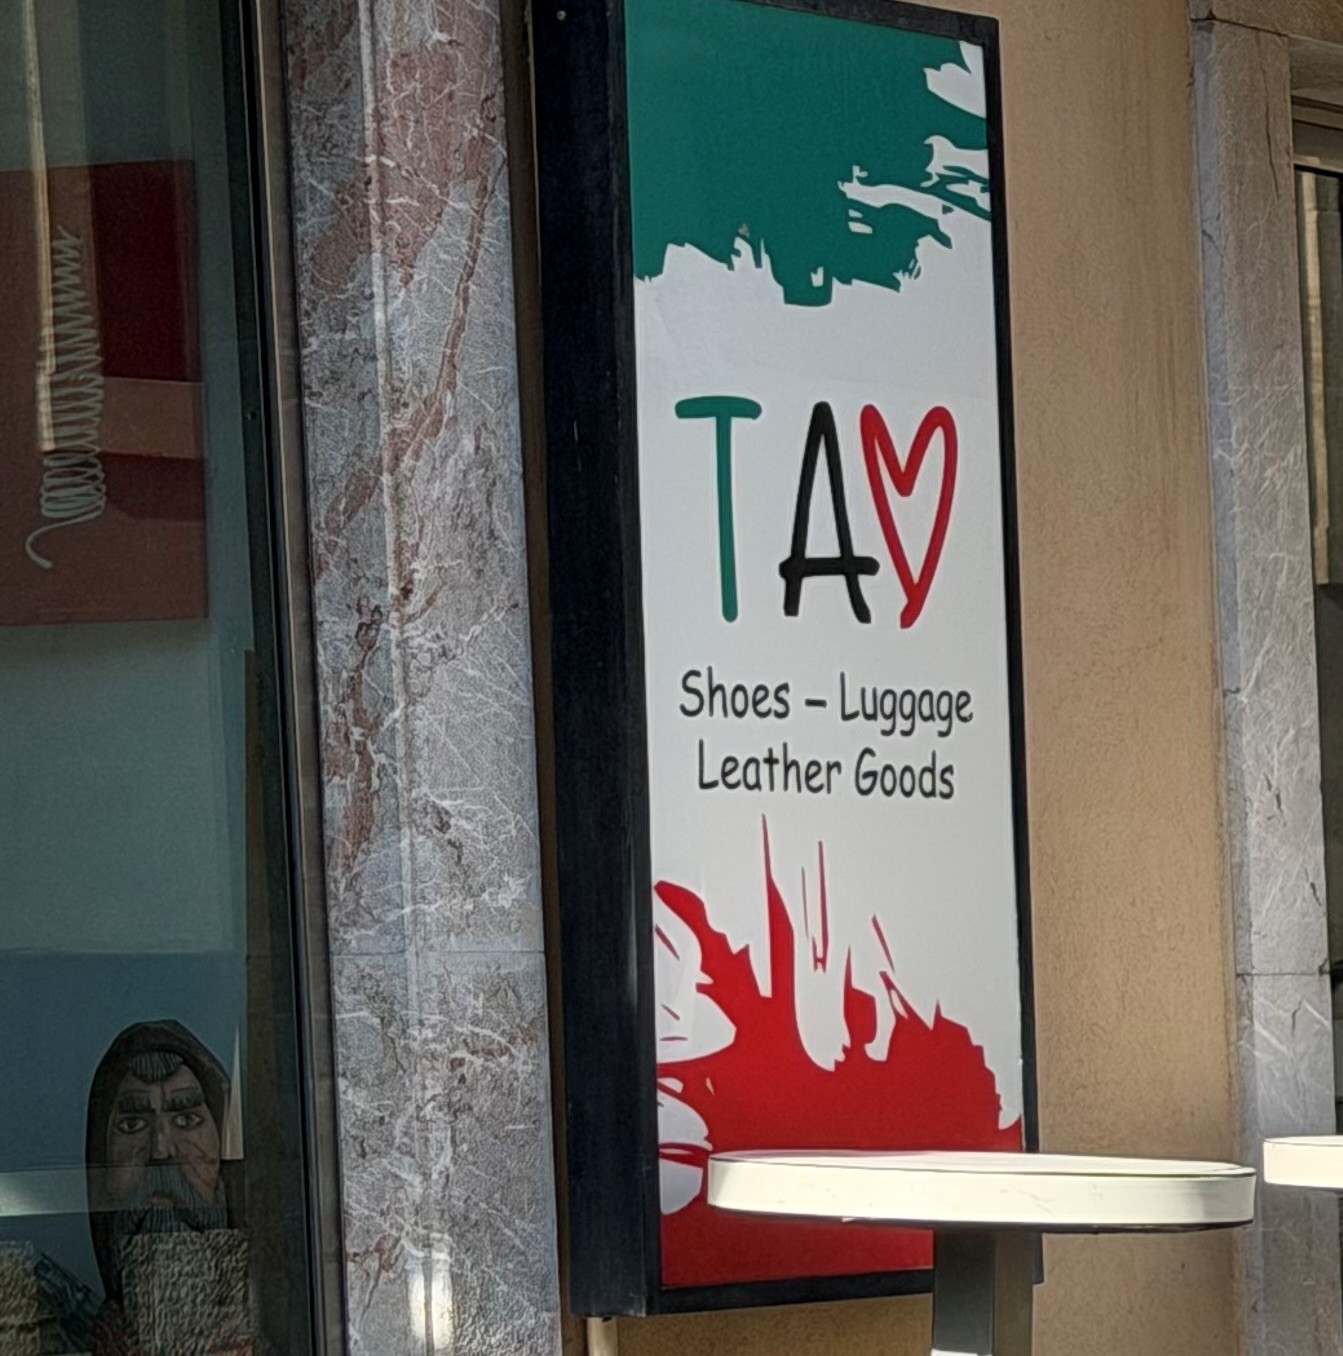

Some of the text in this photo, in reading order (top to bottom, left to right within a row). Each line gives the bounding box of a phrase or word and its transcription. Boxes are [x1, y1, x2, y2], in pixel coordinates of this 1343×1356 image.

[679, 665, 791, 719] Shoes
[839, 671, 974, 738] Luggage
[698, 738, 955, 800] Leather Goods
